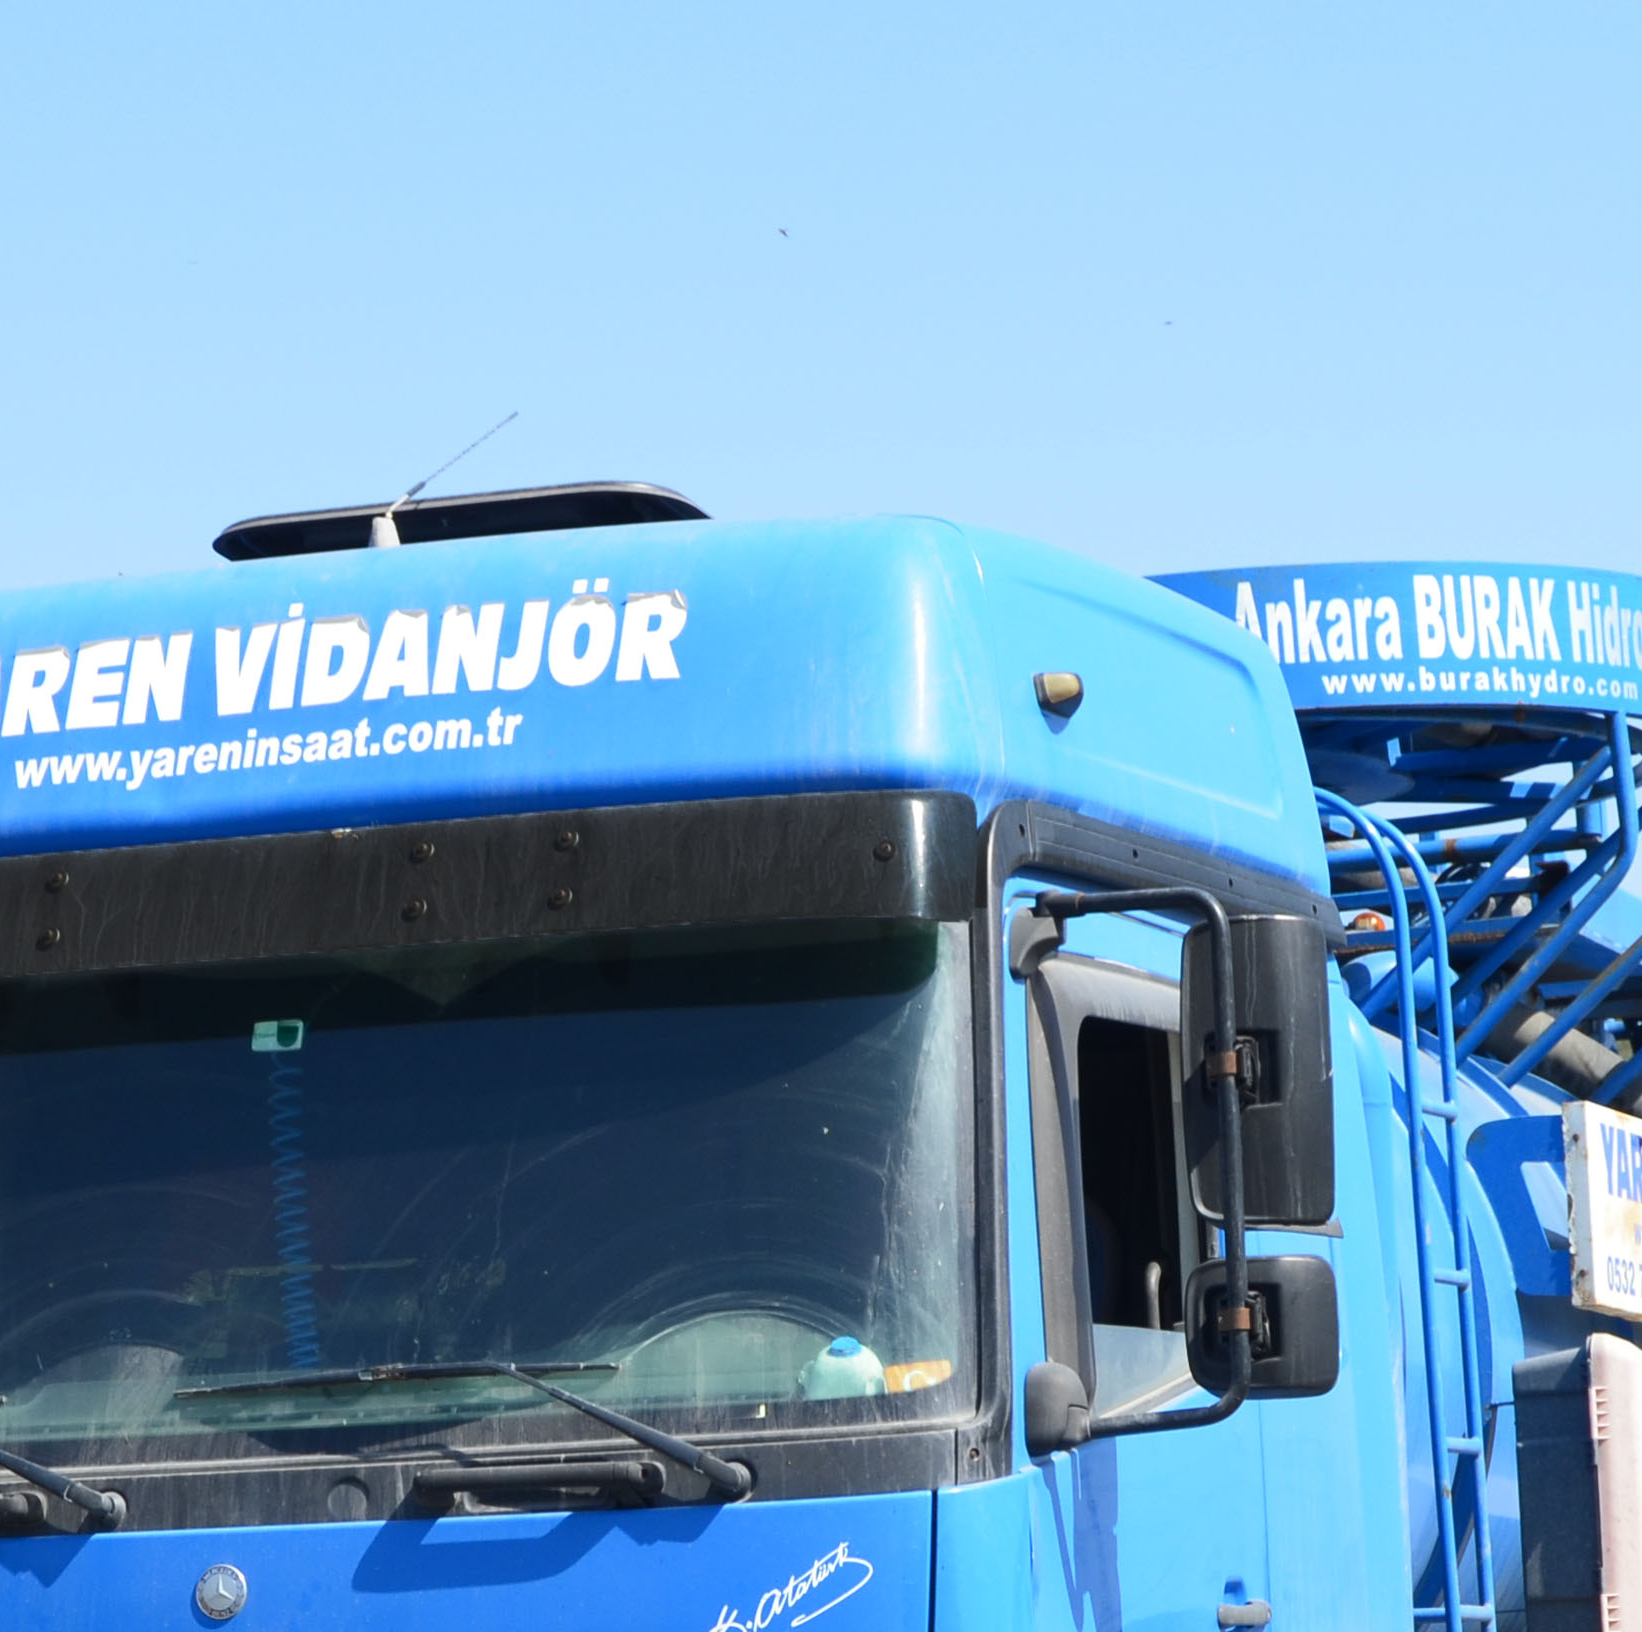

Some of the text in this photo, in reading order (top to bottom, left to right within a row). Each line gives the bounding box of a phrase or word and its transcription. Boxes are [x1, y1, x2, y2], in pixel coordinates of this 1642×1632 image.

[215, 577, 688, 716] VİDANJÖR
[1234, 577, 1403, 664] Ankara
[1413, 574, 1561, 661] BURAK
[1321, 666, 1638, 699] www.burakhydro.com
[14, 706, 523, 791] www.yareninsaat.com.tr
[1608, 1256, 1636, 1296] 0532
